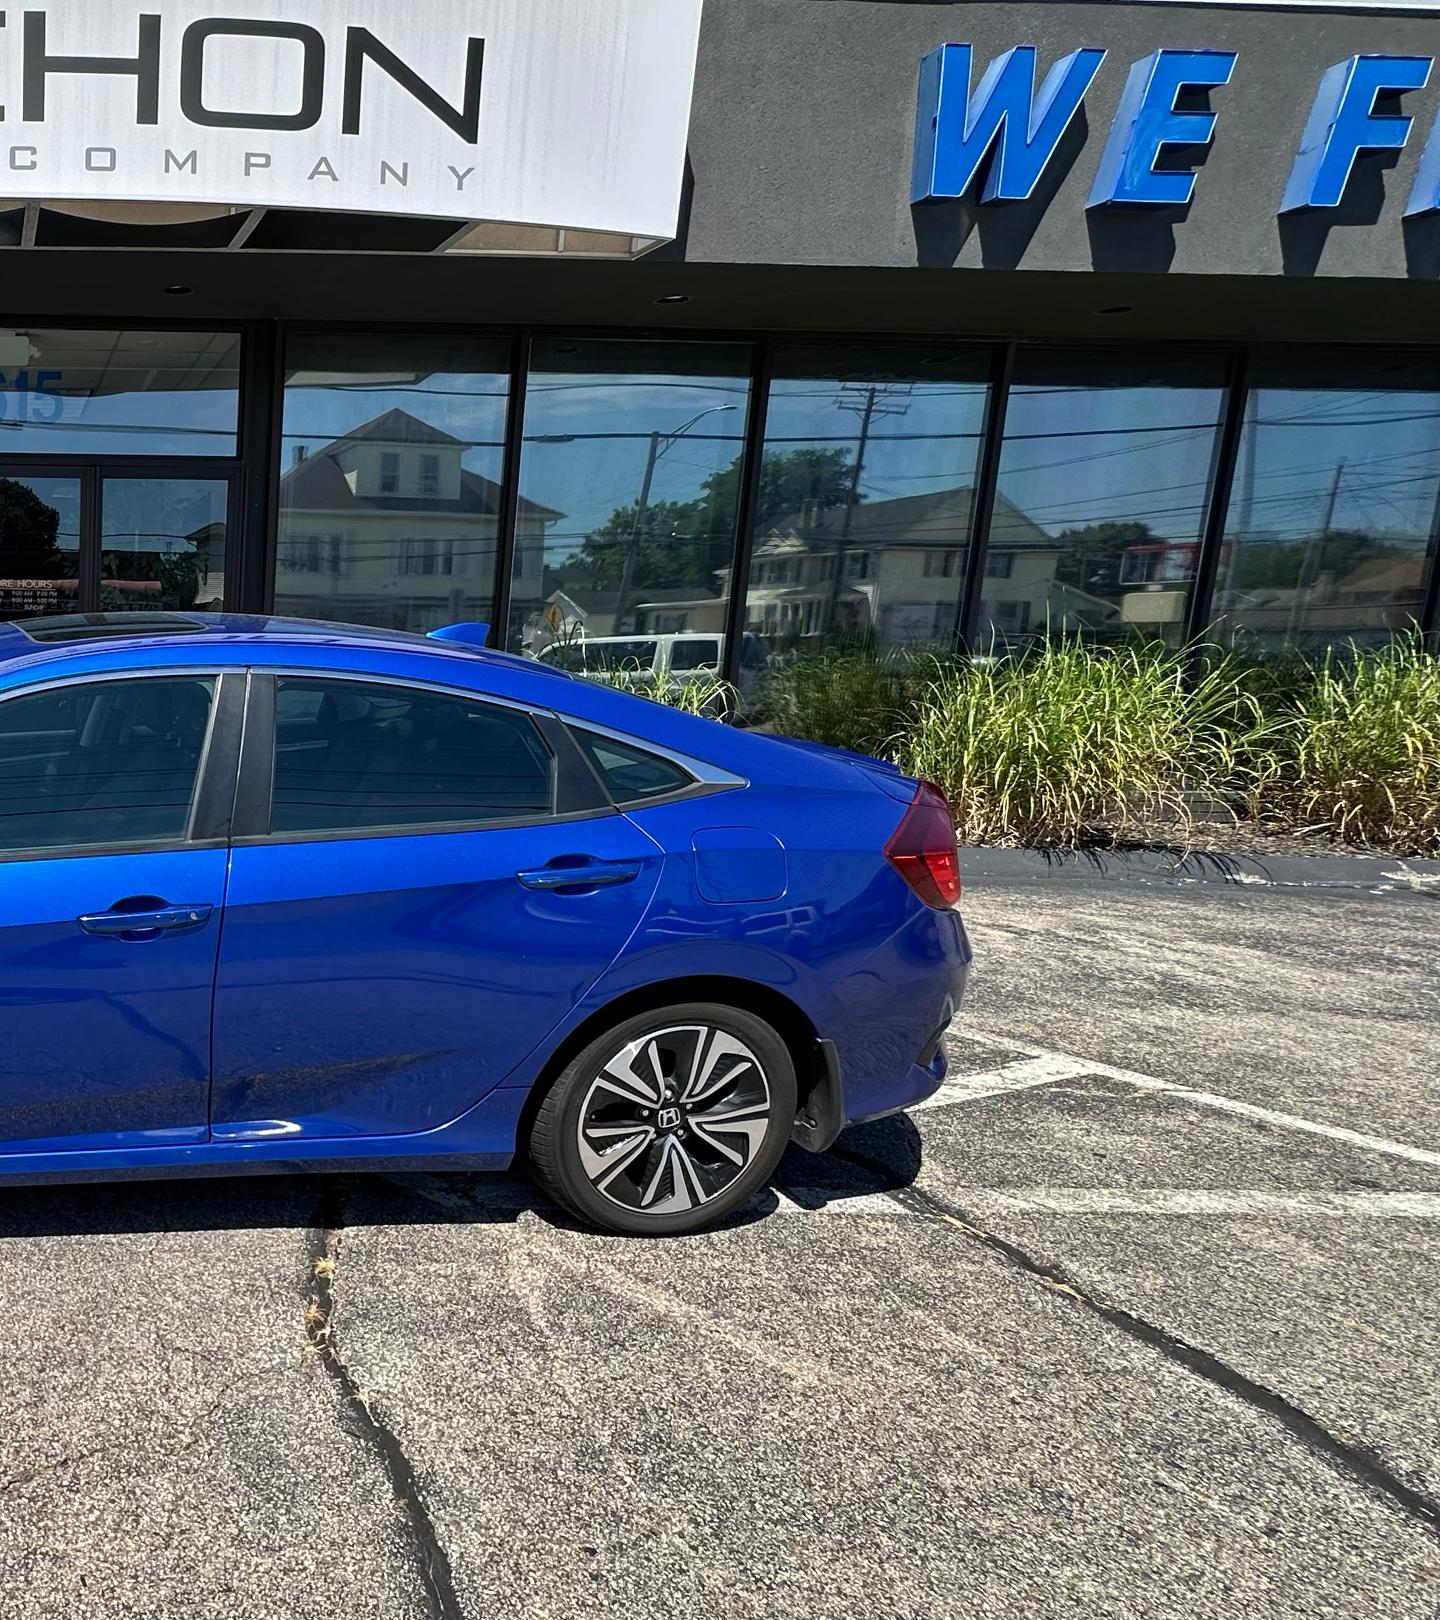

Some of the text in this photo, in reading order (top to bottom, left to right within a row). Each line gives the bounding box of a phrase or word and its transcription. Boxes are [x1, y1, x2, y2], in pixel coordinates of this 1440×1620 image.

[909, 43, 1440, 219] WE F
[9, 145, 477, 191] COMPANY
[17, 579, 53, 589] HOURS
